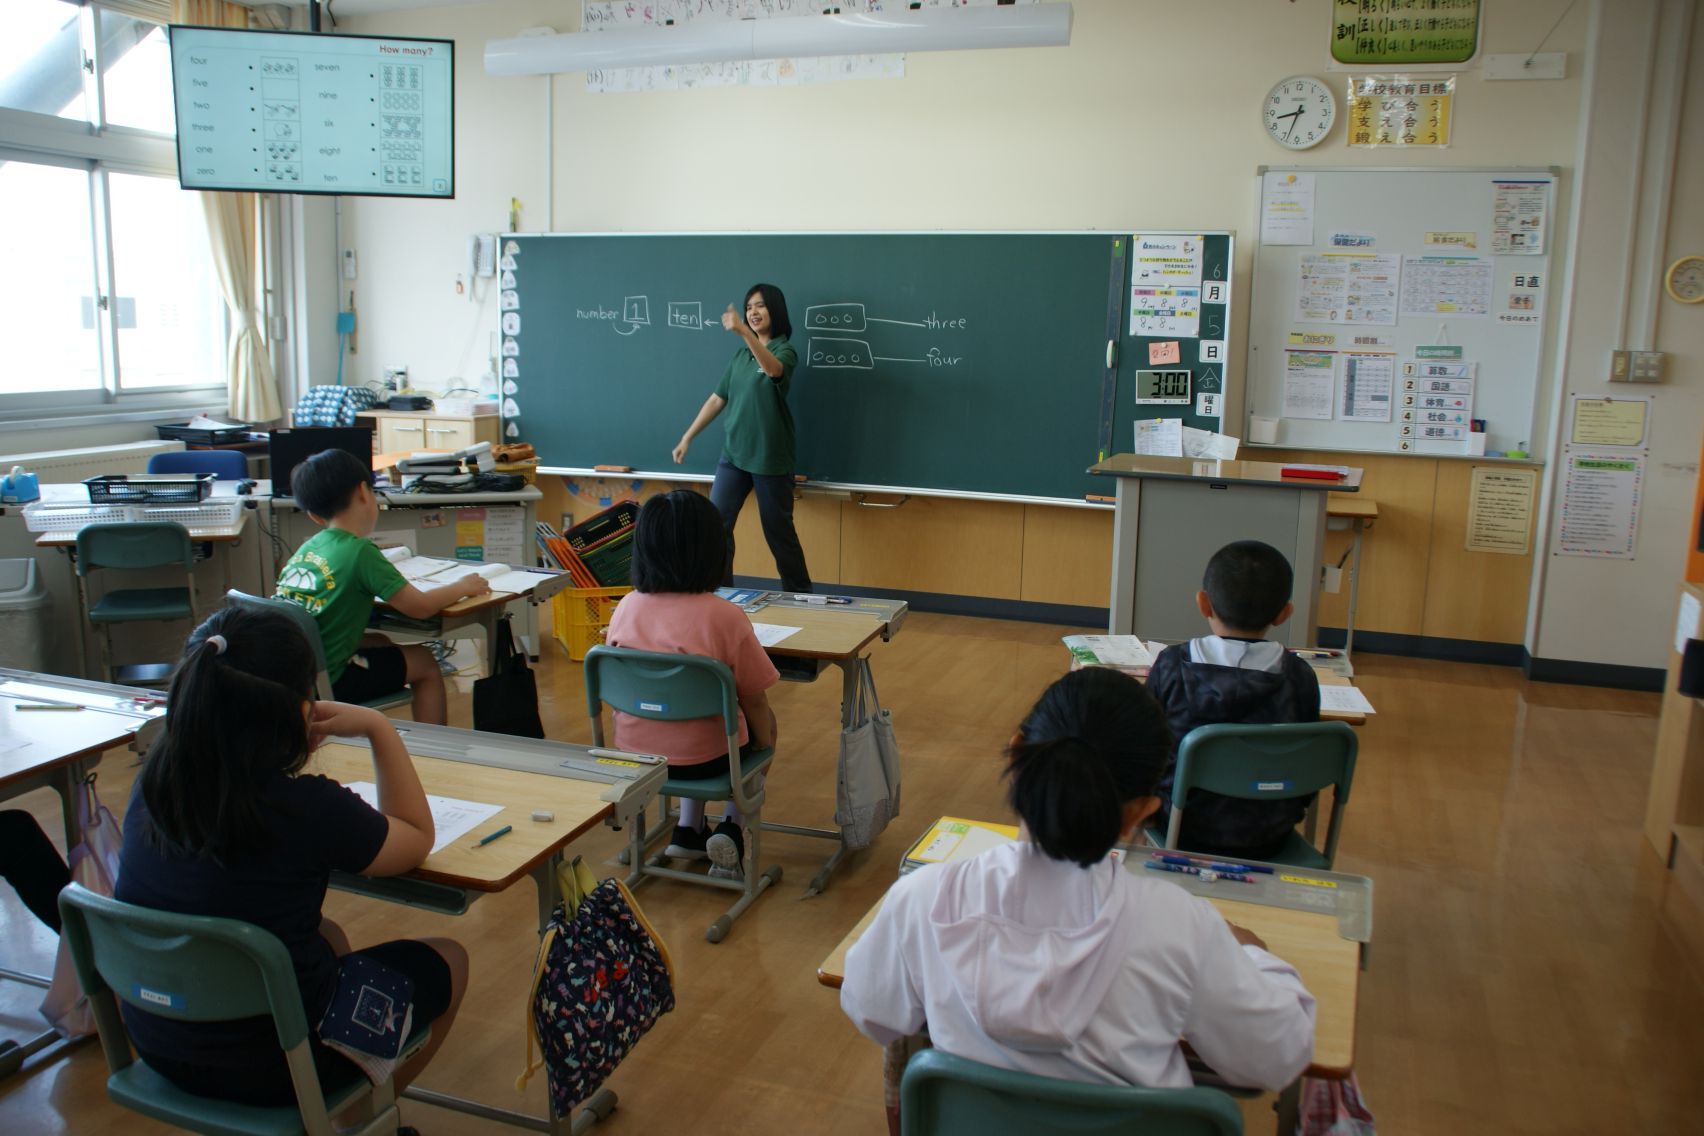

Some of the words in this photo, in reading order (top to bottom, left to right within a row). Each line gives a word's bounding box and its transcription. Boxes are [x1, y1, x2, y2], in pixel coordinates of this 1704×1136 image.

[380, 45, 399, 54] How
[402, 47, 433, 56] many?
[190, 56, 208, 65] four
[192, 79, 208, 87] five
[319, 90, 338, 99] nine
[194, 102, 210, 110] two
[192, 123, 214, 132] three
[324, 119, 334, 127] six
[319, 146, 341, 156] eight
[324, 174, 338, 182] ten
[1214, 264, 1220, 279] 6
[1515, 276, 1539, 288] 日直
[1209, 286, 1219, 300] 月
[576, 304, 619, 320] number
[629, 303, 645, 320] 1
[672, 308, 698, 325] ten
[924, 312, 967, 329] three
[1209, 315, 1220, 336] 5
[1208, 346, 1217, 358] 日
[926, 348, 963, 367] four
[1151, 372, 1187, 396] 3:00
[1407, 381, 1413, 389] 2
[1426, 398, 1445, 407] 体育
[1428, 413, 1447, 421] 社会
